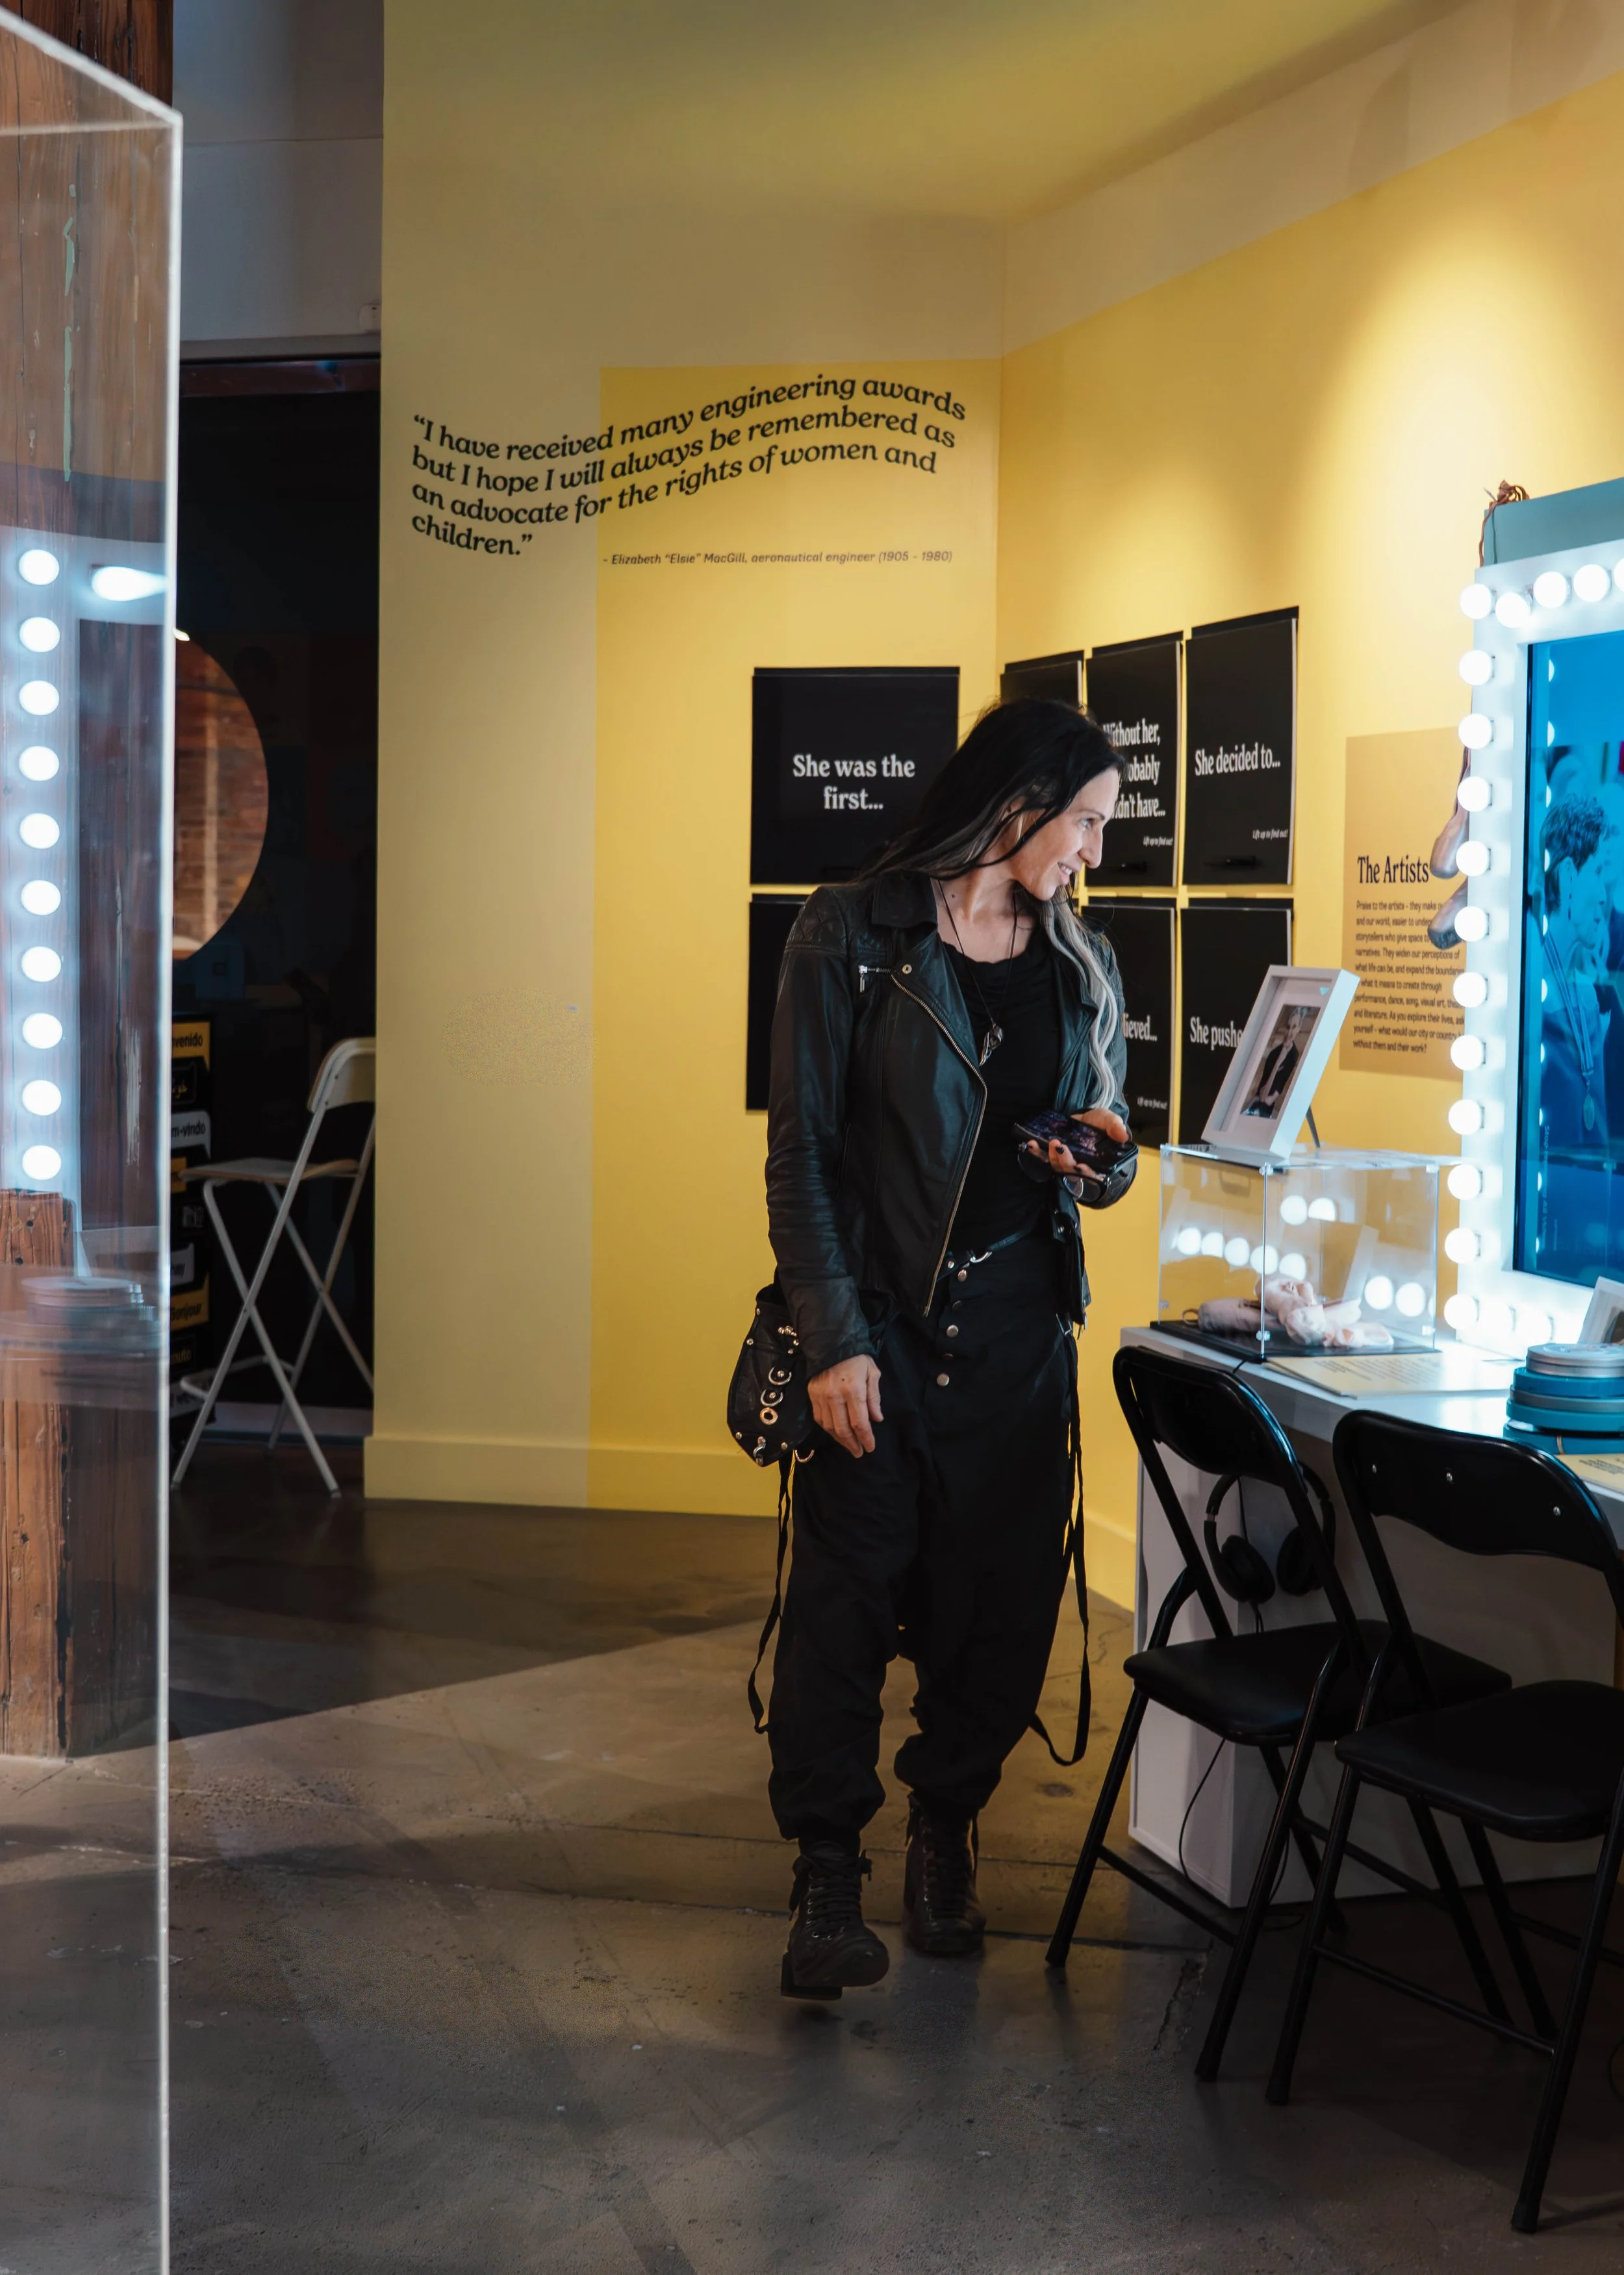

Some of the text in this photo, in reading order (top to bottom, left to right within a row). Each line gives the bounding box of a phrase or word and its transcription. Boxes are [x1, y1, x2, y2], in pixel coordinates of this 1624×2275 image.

[439, 425, 500, 459] have
[506, 425, 614, 461] received
[620, 411, 694, 446] many
[700, 374, 856, 422] engineering
[863, 379, 966, 420] awards
[412, 404, 956, 497] but I hope I will always be remembered as
[412, 443, 937, 524] an advocate for the rights of women and
[412, 514, 533, 555] children.”
[611, 553, 661, 565] Elizabeth
[665, 553, 702, 564] “Elsie”
[704, 552, 748, 564] MacGill,
[751, 552, 823, 563] aeronautical
[826, 552, 876, 565] engineer
[878, 551, 909, 563] (1905
[921, 551, 952, 563] 1980)
[1141, 717, 1160, 746] her,
[792, 753, 916, 778] She was the
[1128, 754, 1160, 785] obably
[1195, 741, 1281, 776] She decided to...
[823, 785, 884, 810] first...
[1136, 791, 1166, 818] have...
[1357, 852, 1429, 884] The Artists
[1379, 901, 1388, 910] the
[1410, 901, 1421, 913] they
[1356, 917, 1365, 926] and
[1356, 932, 1384, 943] storytellers
[1397, 934, 1407, 945] give
[1408, 935, 1423, 945] space
[1382, 947, 1394, 960] They
[1395, 948, 1410, 958] widen
[1421, 950, 1453, 960] perceptions
[1454, 949, 1460, 959] of
[1355, 962, 1367, 971] what
[1395, 964, 1405, 973] and
[1406, 965, 1425, 975] expand
[1425, 965, 1434, 974] the
[1421, 981, 1442, 994] through
[1421, 997, 1436, 1007] visual
[1354, 1009, 1363, 1018] and
[1397, 1012, 1406, 1023] you
[1407, 1013, 1427, 1024] explore
[1428, 1013, 1440, 1023] their
[1190, 1016, 1243, 1051] She pushe
[1354, 1024, 1374, 1035] yourself
[1378, 1025, 1391, 1035] what
[1392, 1027, 1408, 1037] would
[1418, 1028, 1428, 1040] city
[1353, 1039, 1371, 1049] without
[1373, 1040, 1386, 1050] them
[1387, 1042, 1396, 1050] and
[1397, 1043, 1409, 1052] their
